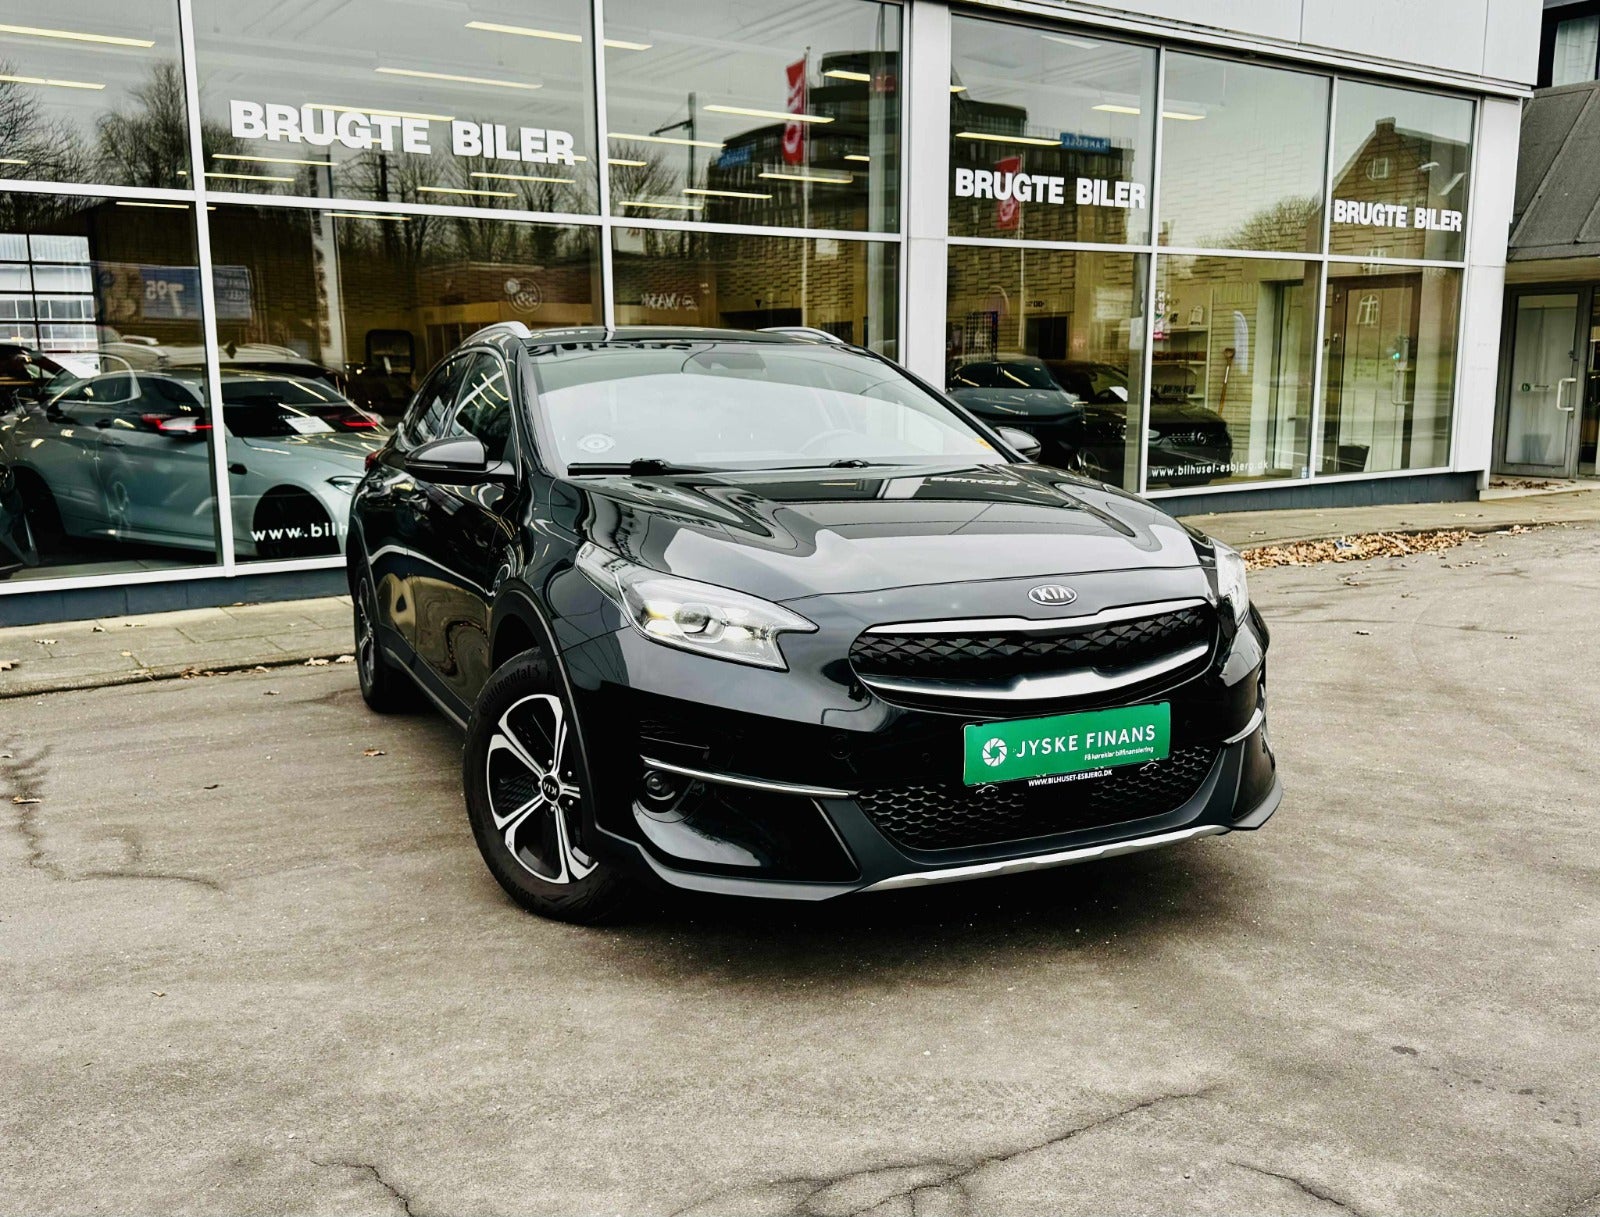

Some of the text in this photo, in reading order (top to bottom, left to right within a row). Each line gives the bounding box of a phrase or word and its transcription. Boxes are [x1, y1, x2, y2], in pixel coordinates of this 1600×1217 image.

[229, 99, 575, 166] BRUGTE BILER
[955, 167, 1146, 209] BRUGTE BILER
[1333, 199, 1463, 232] BRUGTE BILER
[1038, 587, 1073, 601] KIA
[1015, 724, 1156, 758] JYSKE FINANS
[543, 781, 558, 796] KIA
[1028, 769, 1113, 787] WWW.BILHUSET-ESBJERG.DK
